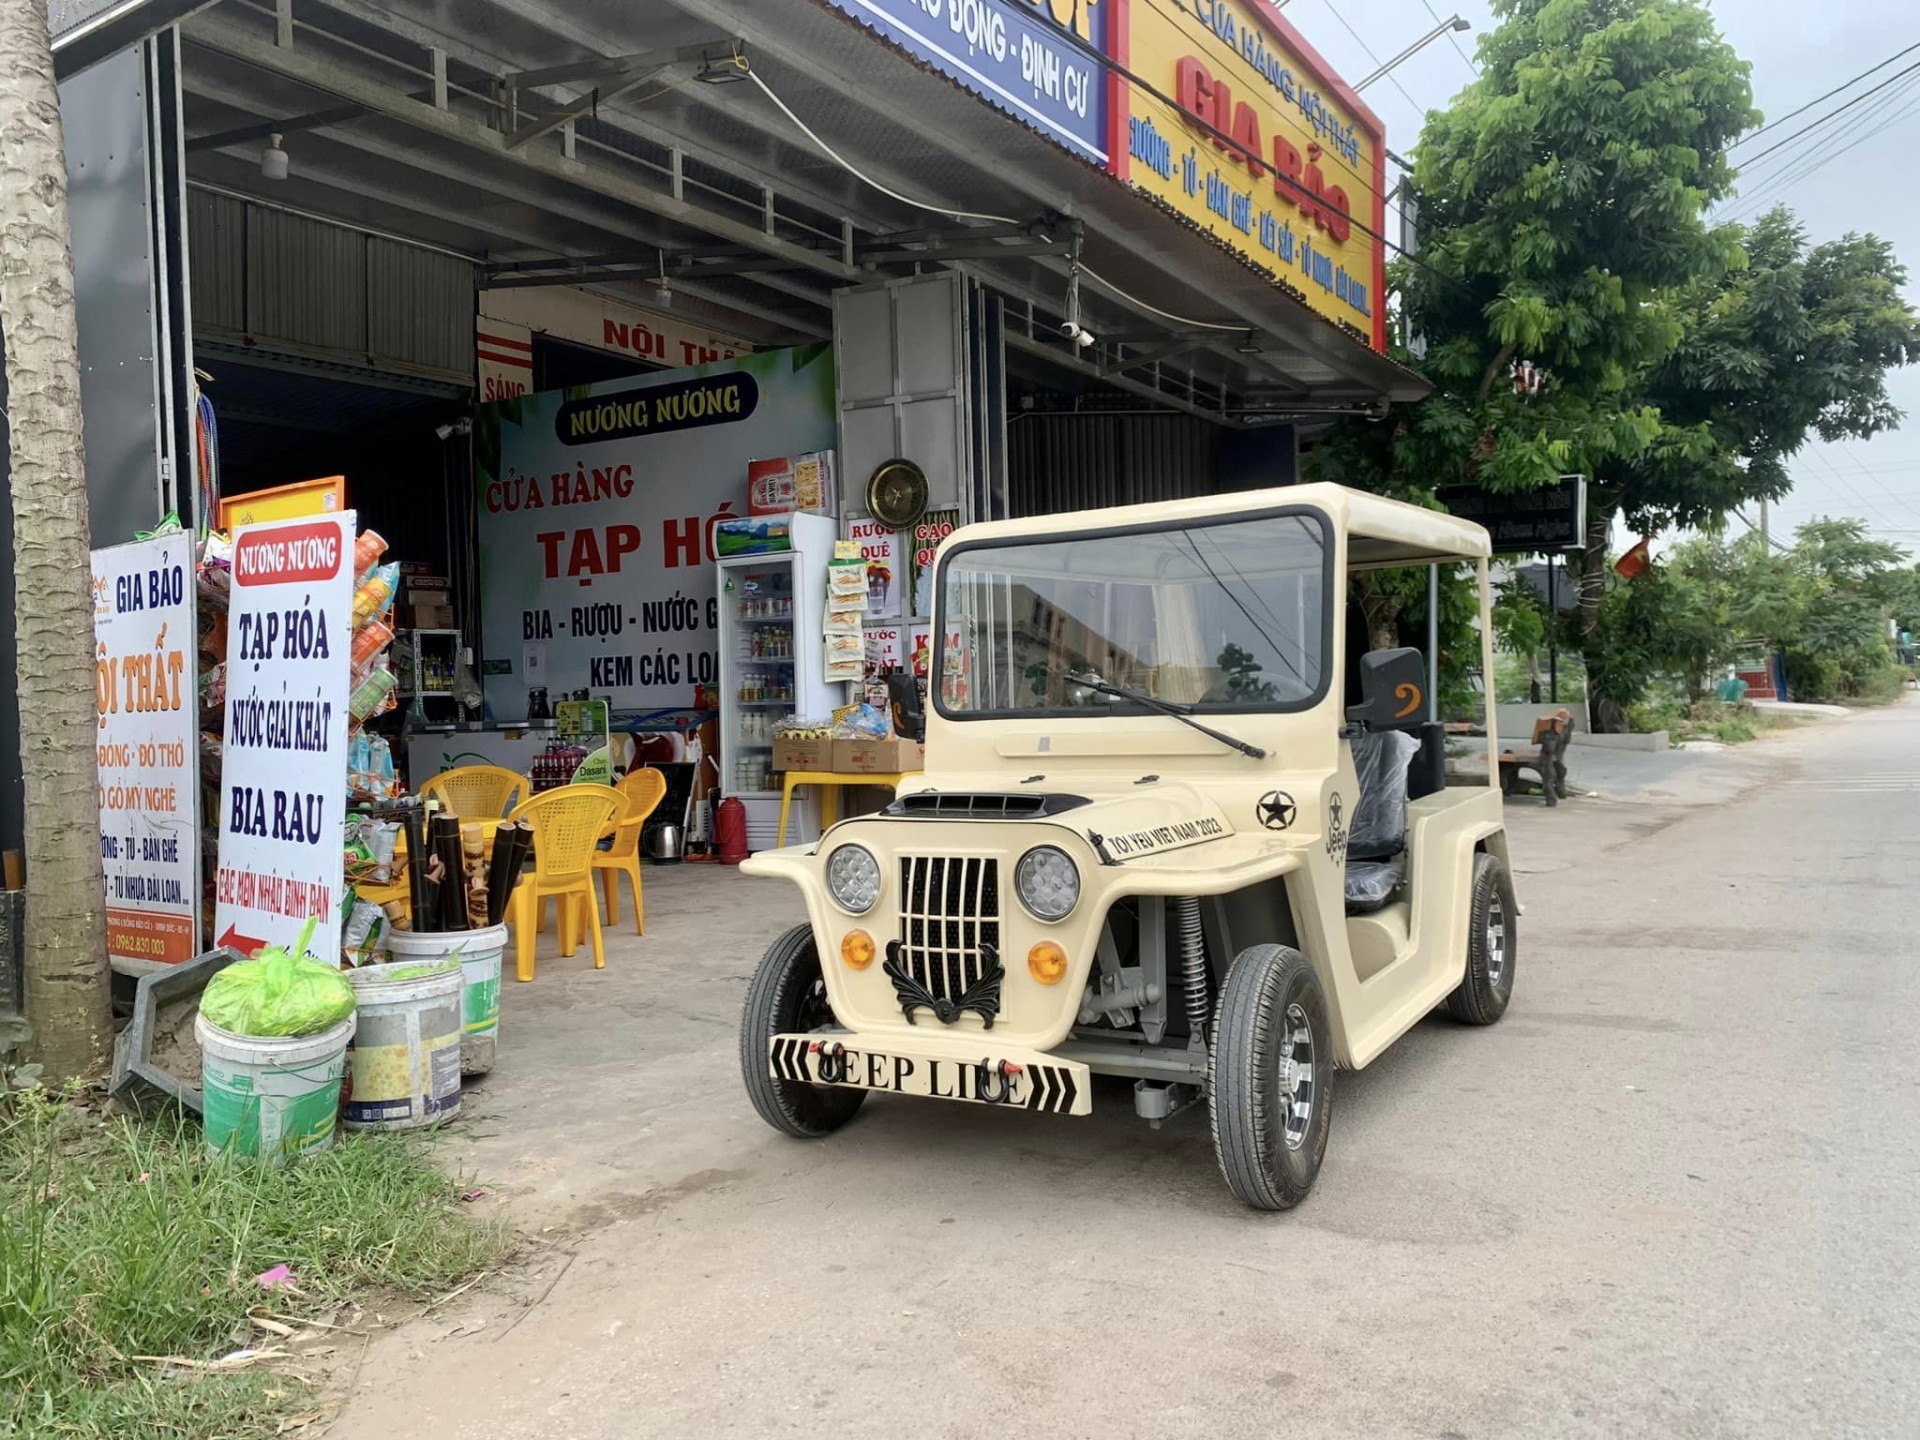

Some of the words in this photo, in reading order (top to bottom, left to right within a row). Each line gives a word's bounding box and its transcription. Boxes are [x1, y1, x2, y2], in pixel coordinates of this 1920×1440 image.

[1176, 55, 1264, 179] GIA
[1274, 135, 1350, 242] BẢO
[603, 319, 665, 360] NỘI
[679, 340, 735, 366] TH
[570, 402, 649, 436] NƯƠNG
[656, 384, 741, 424] NƯƠNG
[486, 467, 544, 514] CỬA
[551, 461, 635, 506] HÀNG
[239, 541, 285, 576] NƯƠNG
[287, 534, 337, 571] NƯƠNG
[536, 524, 641, 587] TẠP
[861, 541, 891, 561] QUÊ
[916, 522, 953, 541] GẠO
[116, 573, 144, 614] GIA
[149, 550, 183, 609] BẢO
[239, 611, 279, 672] TẠP
[284, 593, 330, 660] HÓA
[523, 609, 553, 640] BIA
[571, 602, 623, 643] RƯỢU
[643, 590, 699, 633] NƯỚC
[96, 641, 118, 729] ỘI
[123, 622, 183, 713] THẤT
[590, 656, 633, 688] KEM
[639, 647, 680, 686] CÁC
[231, 685, 265, 747] NƯỚC
[266, 680, 293, 749] GIẢI
[294, 685, 331, 752] KHÁT
[579, 765, 607, 776] Dasani
[230, 786, 267, 837] BIA
[272, 790, 324, 845] RAU
[1107, 835, 1134, 855] TOI
[1128, 831, 1154, 851] YEU
[1149, 826, 1175, 846] VIET
[1172, 822, 1200, 841] NAM
[1196, 817, 1222, 836] 2023
[1326, 826, 1347, 854] Jeep
[143, 833, 160, 862] BÀN
